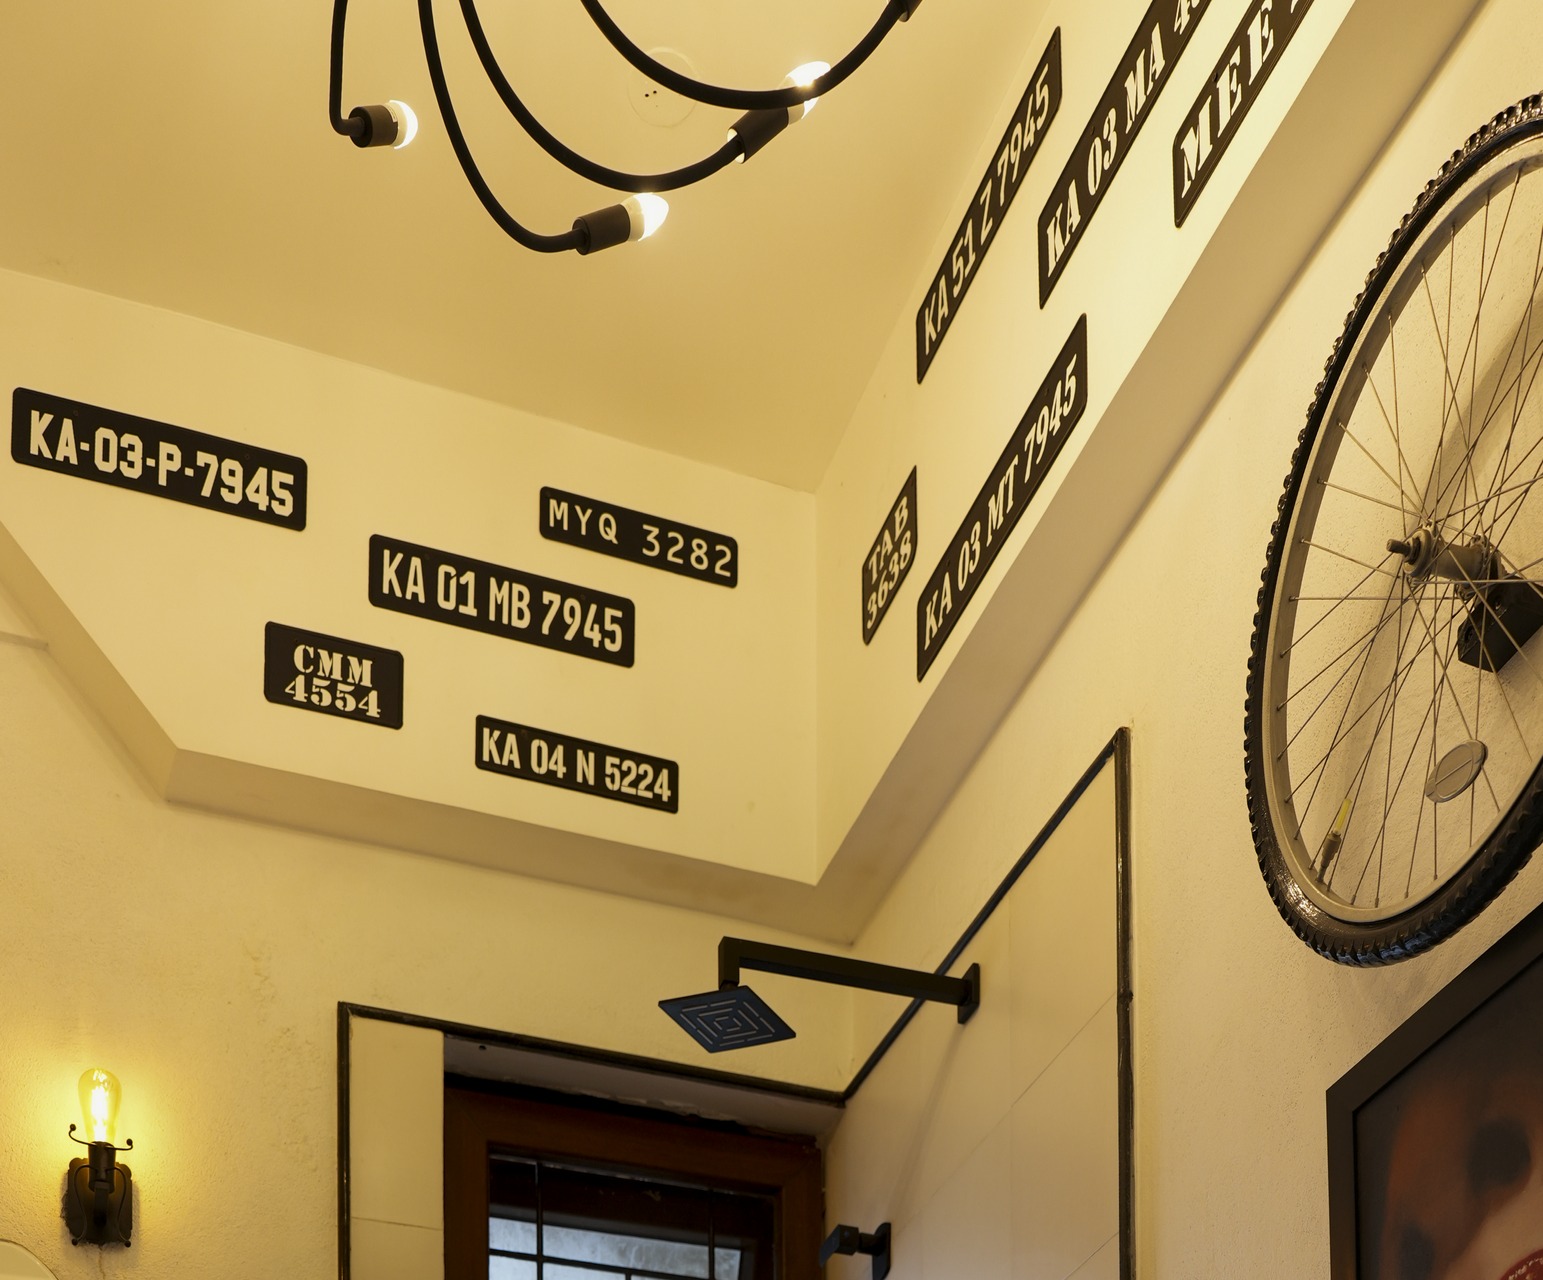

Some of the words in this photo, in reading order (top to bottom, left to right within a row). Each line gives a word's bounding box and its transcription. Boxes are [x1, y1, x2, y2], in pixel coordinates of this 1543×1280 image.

[1046, 179, 1082, 278] KA
[1087, 107, 1118, 196] 03
[1124, 22, 1166, 135] MA
[1180, 0, 1274, 199] MEE
[924, 274, 949, 356] KA
[952, 218, 976, 298] 51
[979, 178, 993, 246] Z
[997, 63, 1049, 207] 7945
[29, 409, 294, 517] KA-03-P-7945
[924, 571, 953, 651] KA
[957, 520, 981, 592] 03
[986, 454, 1019, 548] MT
[1024, 353, 1077, 484] 7945
[548, 498, 618, 545] MYQ
[641, 524, 732, 577] 3282
[866, 530, 912, 630] 3638
[868, 496, 909, 585] TAB
[382, 549, 426, 604] KA
[437, 564, 478, 617] 01
[488, 576, 531, 629] MB
[541, 590, 623, 652] 7945
[284, 673, 381, 718] 4554
[293, 644, 373, 688] CMM
[482, 727, 521, 769] KA
[530, 739, 567, 779] 04
[576, 749, 595, 786] N
[604, 755, 672, 802] 5224
